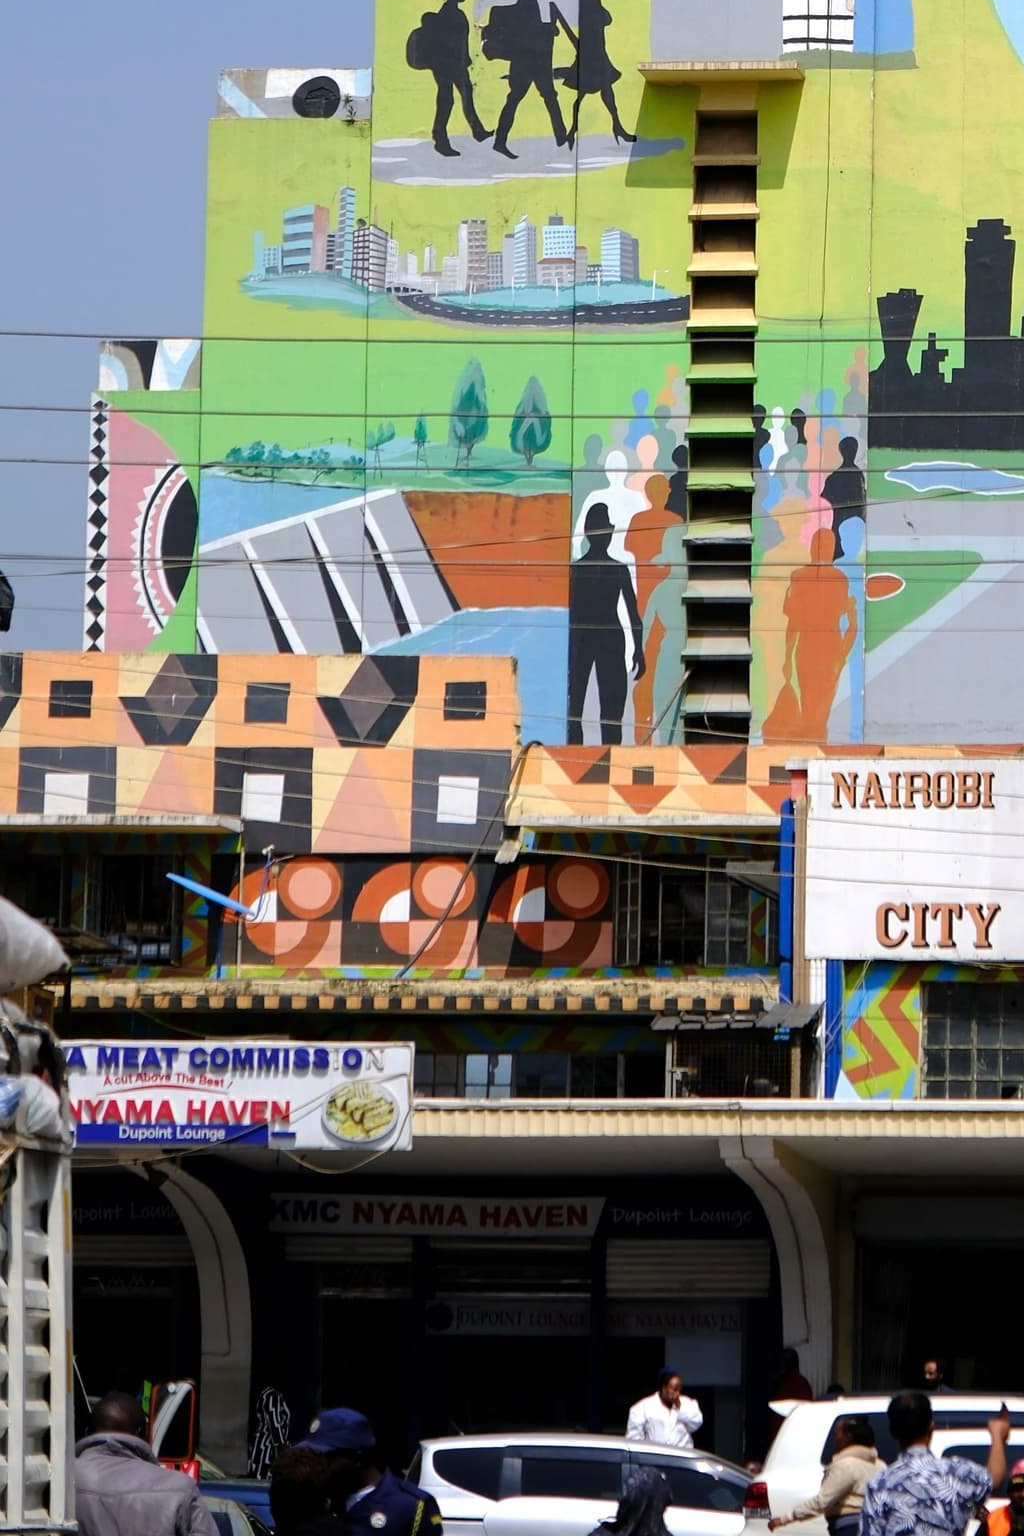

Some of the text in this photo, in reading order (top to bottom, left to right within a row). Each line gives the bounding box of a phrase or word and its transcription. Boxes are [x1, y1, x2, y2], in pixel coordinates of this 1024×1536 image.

[831, 771, 995, 810] NAIROBI
[876, 902, 1001, 948] CITY
[96, 1046, 180, 1070] MEAT
[103, 1076, 112, 1086] A
[114, 1074, 133, 1085] cut
[135, 1072, 171, 1084] Above
[175, 1072, 195, 1084] The
[198, 1075, 224, 1088] Best
[69, 1099, 290, 1125] NYAMA HAVEN
[118, 1125, 226, 1143] Dupoint Lounge
[271, 1200, 588, 1228] KMC NYAMA HAVEN
[610, 1207, 752, 1229] Dupoint Lounge
[458, 1309, 522, 1327] DUPOINT
